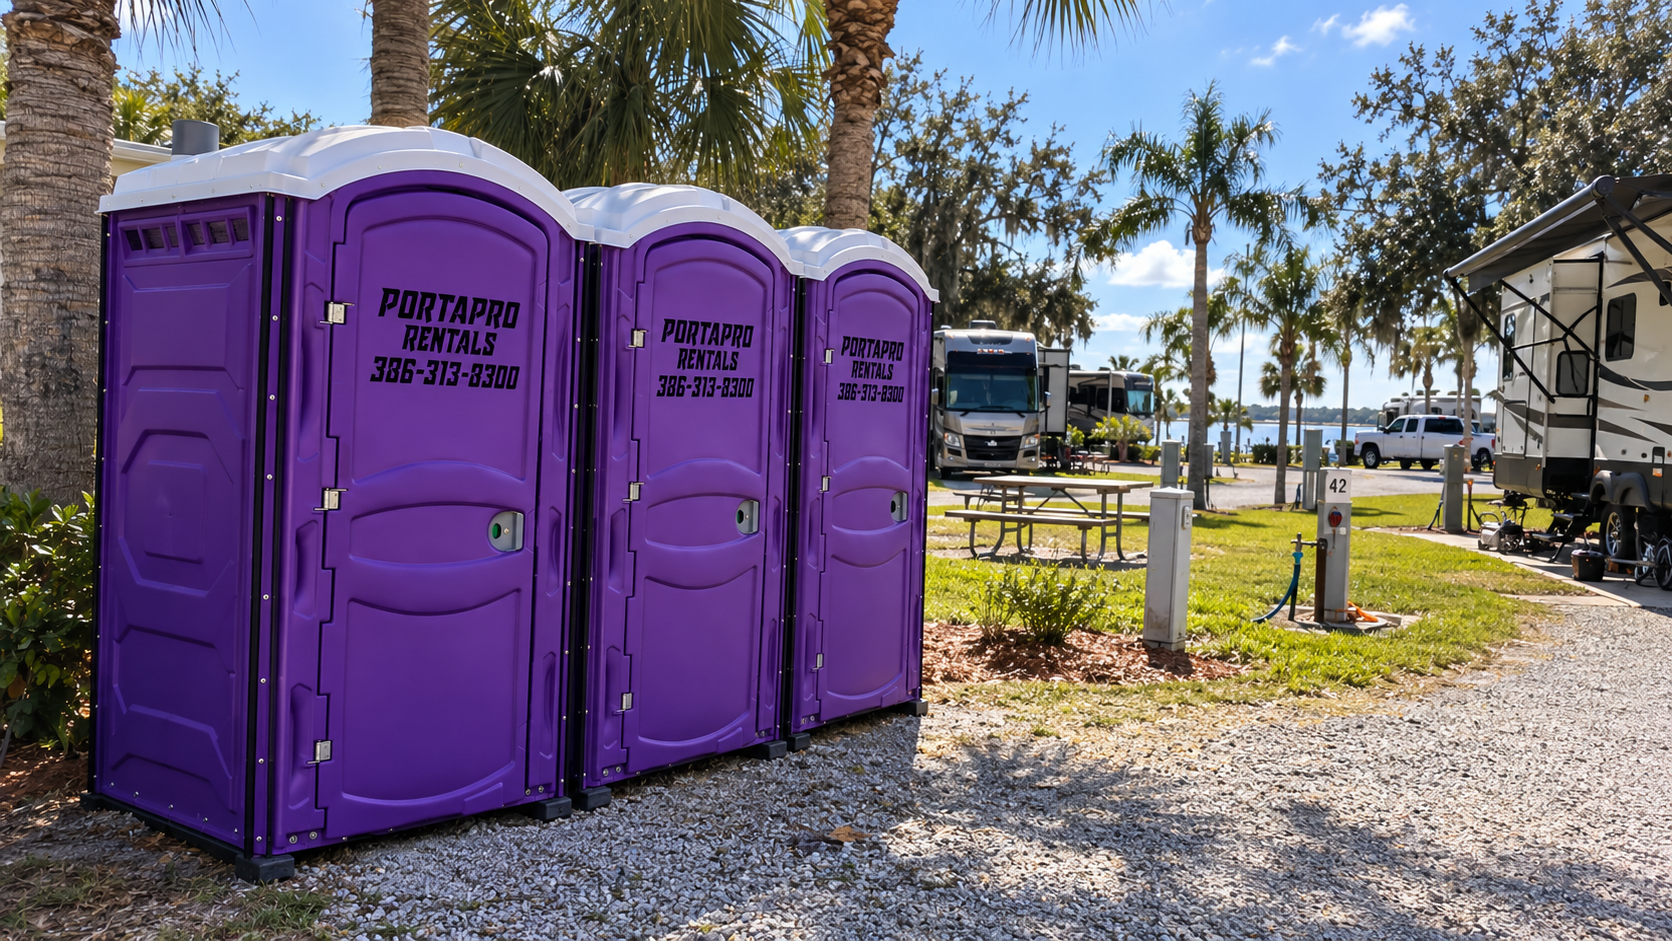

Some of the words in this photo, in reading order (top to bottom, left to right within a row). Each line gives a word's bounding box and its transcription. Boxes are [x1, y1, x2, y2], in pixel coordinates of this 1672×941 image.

[378, 287, 521, 329] PORTAPRO
[402, 325, 497, 356] RENTALS
[661, 318, 754, 348] PORTAPRO
[677, 348, 739, 371] RENTALS
[841, 336, 905, 361] PORTAPRO
[370, 356, 520, 389] 386-313-8300
[851, 361, 894, 380] RENTALS
[656, 375, 754, 398] 386-313-8300
[837, 382, 905, 403] 386-313-8300
[1329, 478, 1347, 493] 42
